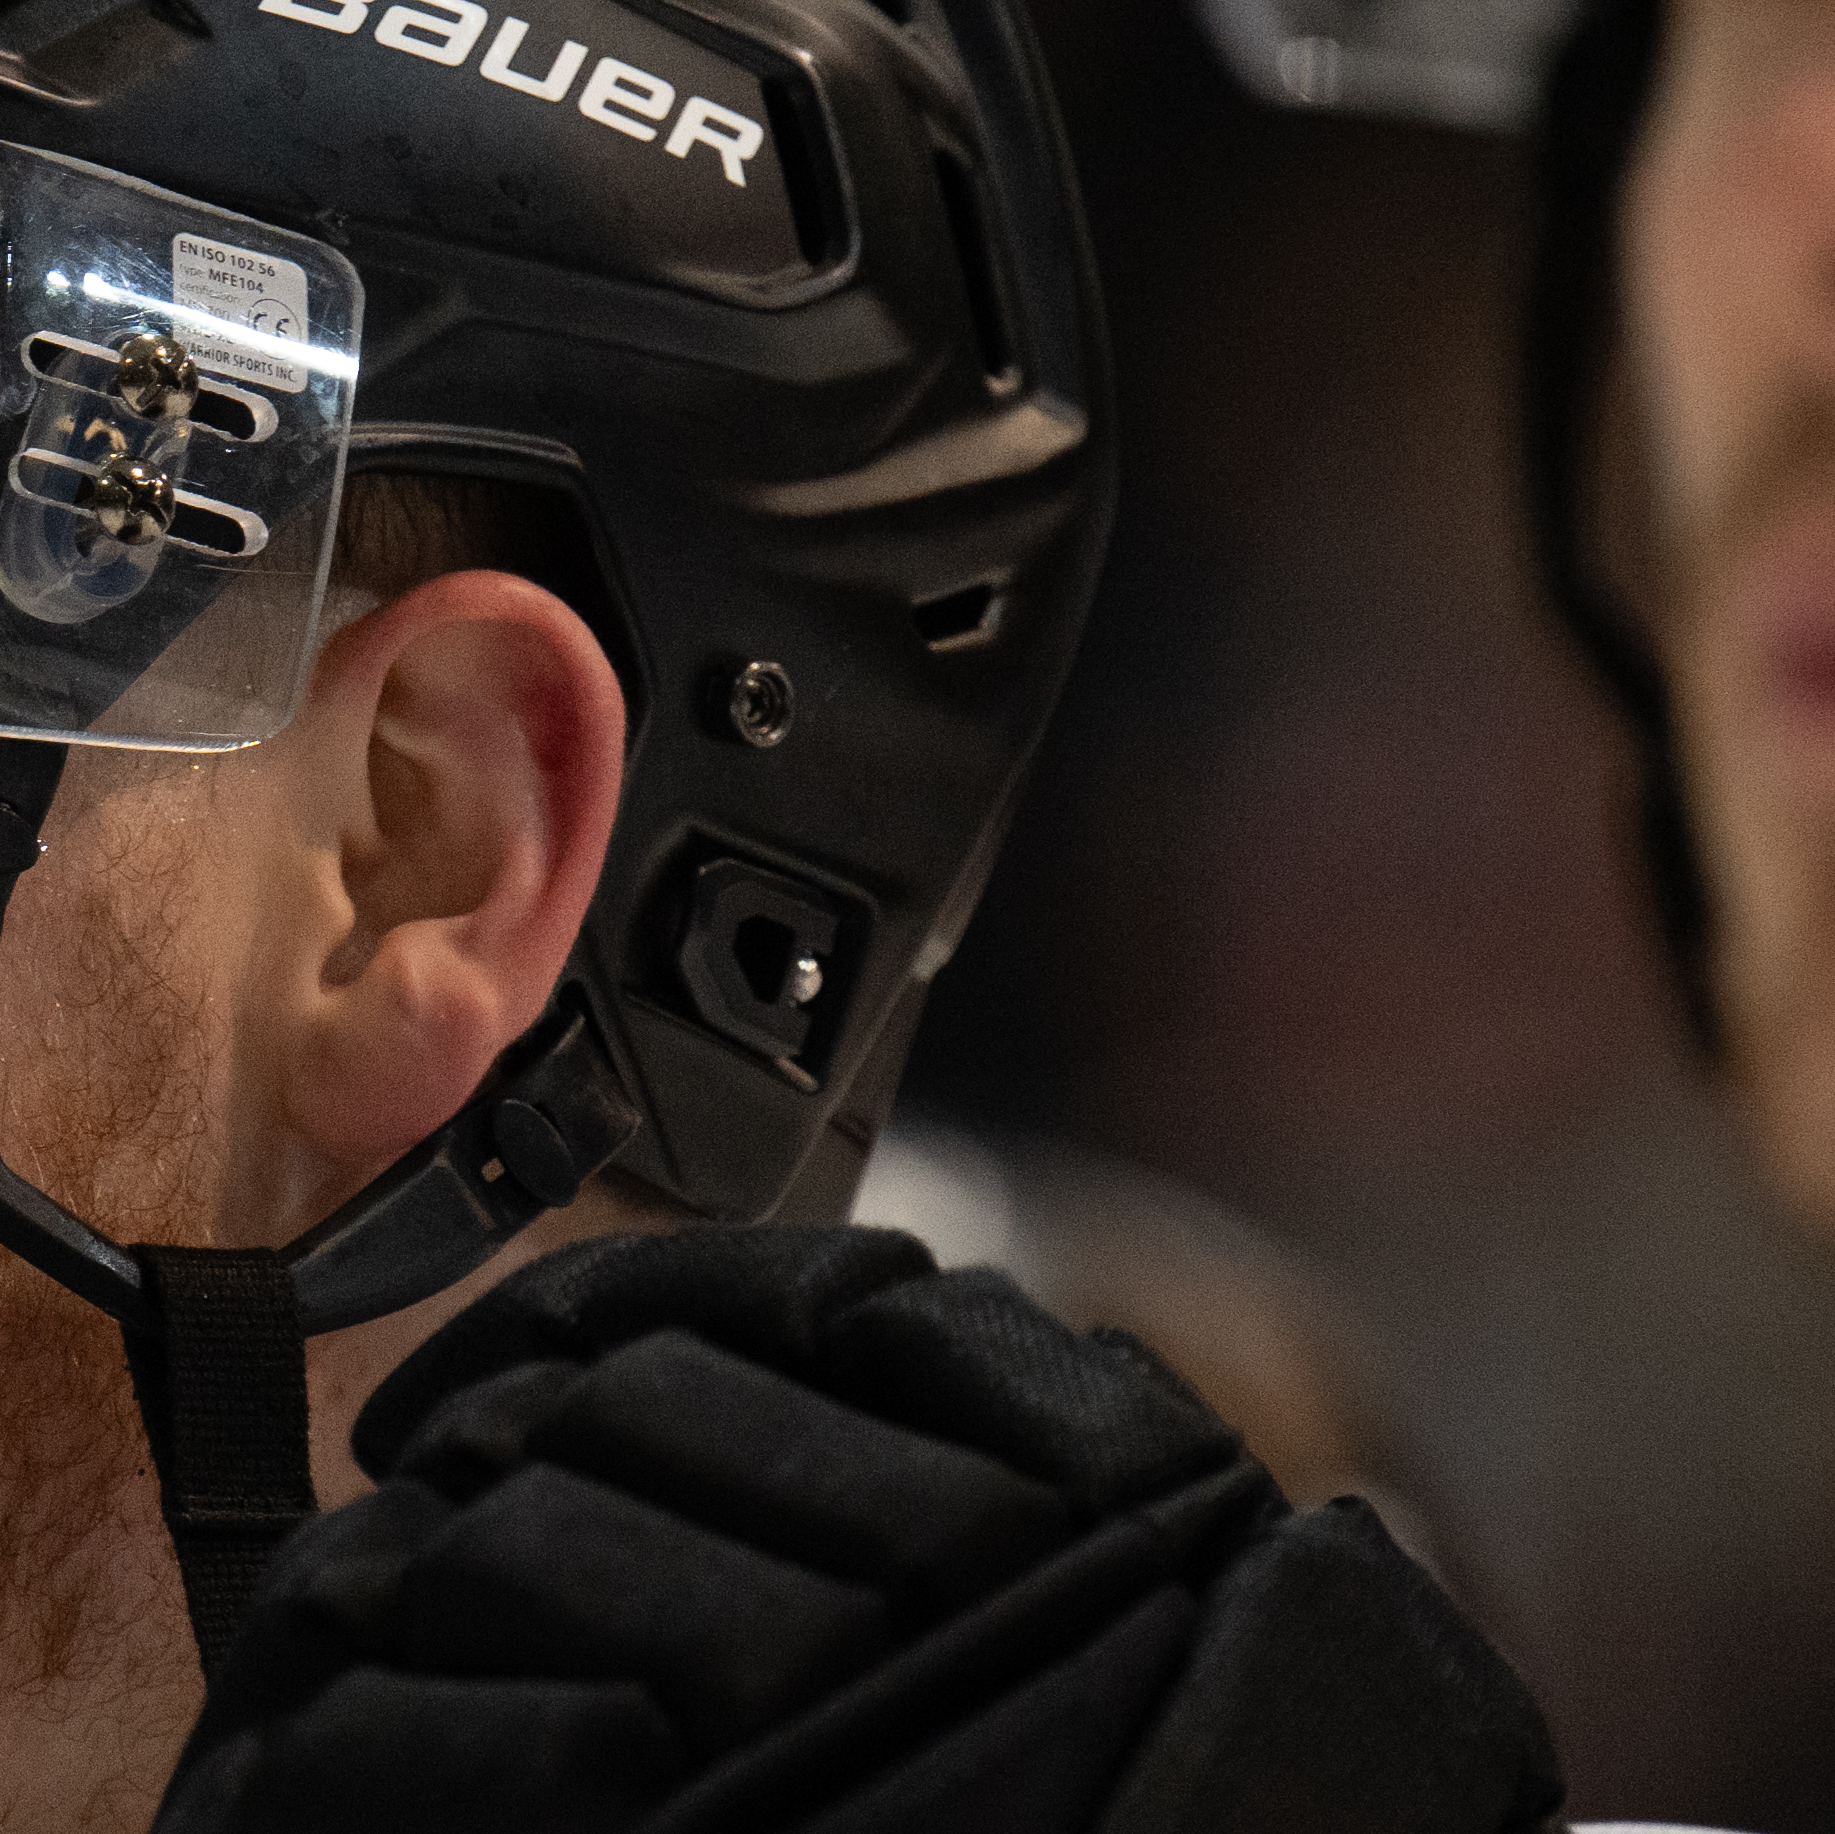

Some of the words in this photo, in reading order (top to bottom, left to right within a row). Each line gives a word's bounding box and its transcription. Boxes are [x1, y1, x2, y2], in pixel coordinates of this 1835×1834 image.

[179, 239, 197, 256] EN
[202, 245, 225, 264] ISO
[230, 254, 254, 271] 102
[258, 261, 275, 278] 56
[208, 267, 264, 294] MFE104
[232, 353, 273, 376] SPORTS
